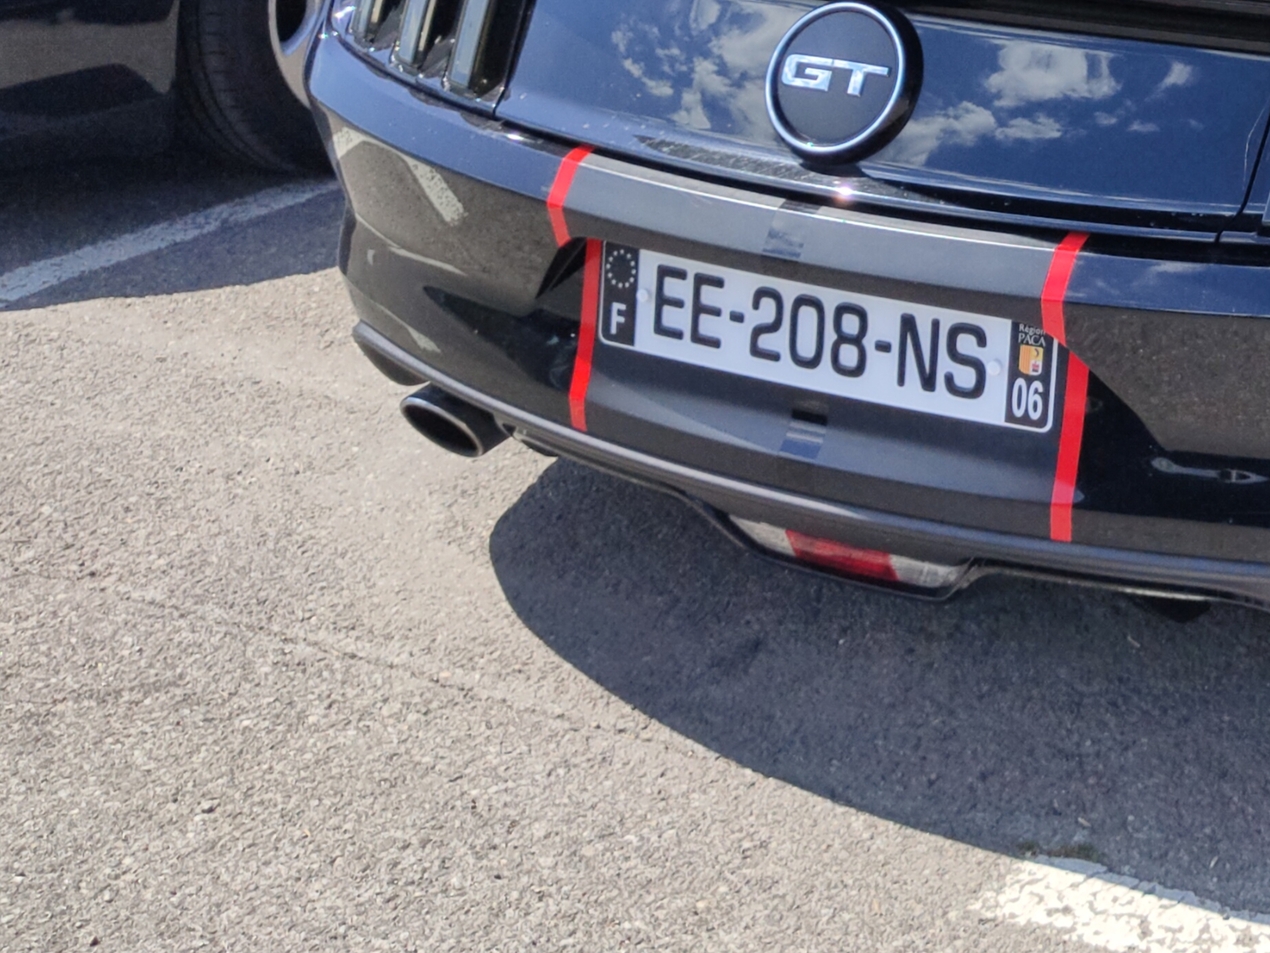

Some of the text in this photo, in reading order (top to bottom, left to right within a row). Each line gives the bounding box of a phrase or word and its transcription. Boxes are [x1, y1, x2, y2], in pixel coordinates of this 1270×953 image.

[780, 53, 890, 96] GT
[610, 302, 626, 335] F
[653, 264, 987, 399] EE-208-NS
[1018, 323, 1046, 336] Région
[1018, 333, 1046, 347] PACA
[1011, 377, 1043, 420] 06
